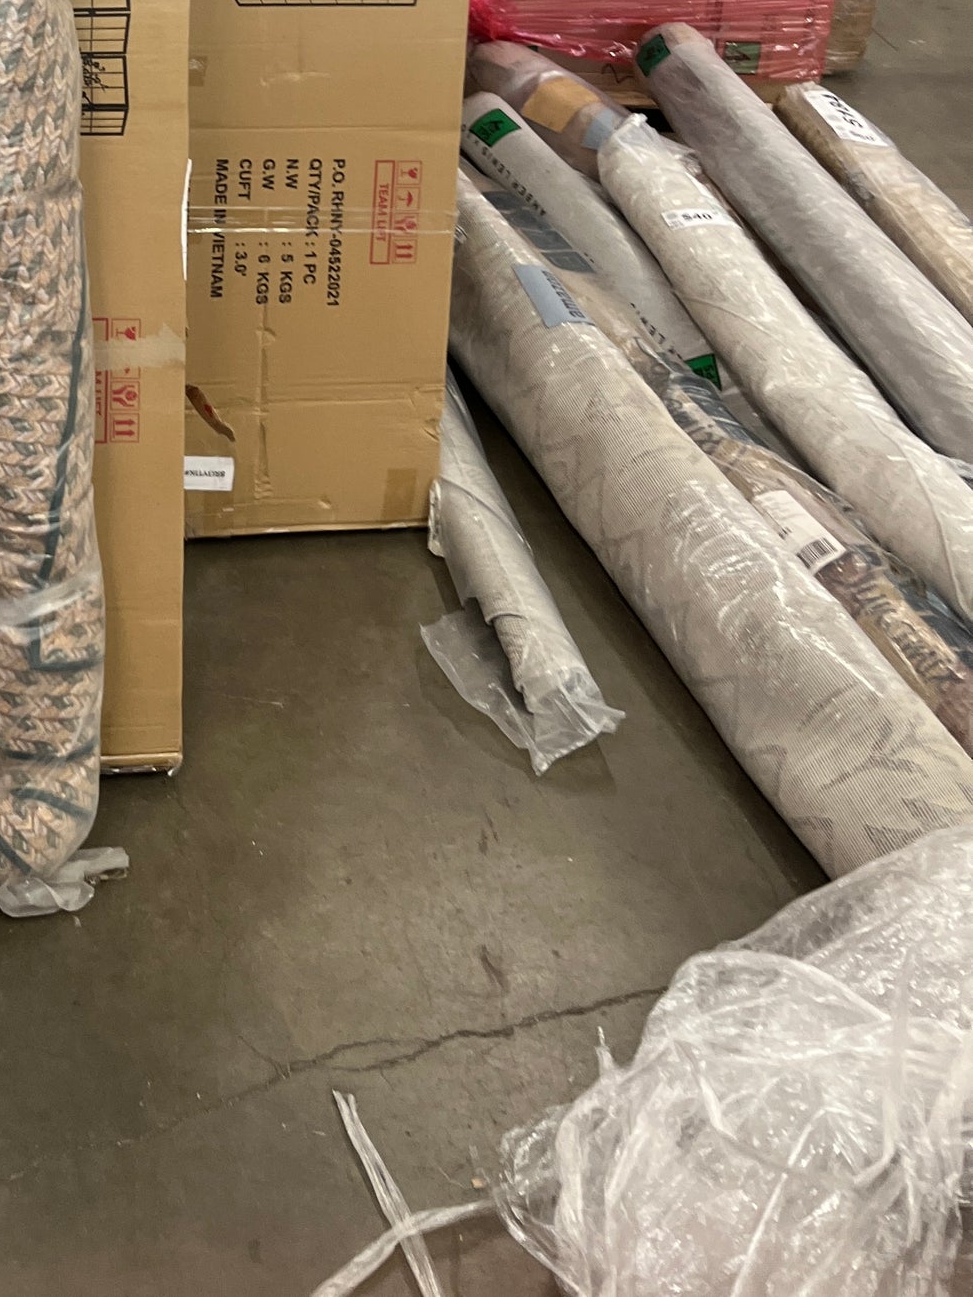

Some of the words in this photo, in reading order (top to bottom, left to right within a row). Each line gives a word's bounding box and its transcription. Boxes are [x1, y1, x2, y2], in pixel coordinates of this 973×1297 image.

[214, 159, 228, 204] MADE
[238, 159, 251, 200] CUFT
[262, 159, 275, 190] G.W
[285, 159, 298, 189] N.W
[332, 159, 345, 187] P.O.
[305, 159, 322, 236] QTY/PACK
[377, 184, 389, 215] TEAM
[214, 209, 226, 225] IN
[376, 220, 387, 242] LIFT
[210, 228, 225, 298] VIETNAM
[258, 255, 269, 263] 6
[282, 254, 293, 262] 5
[327, 191, 344, 306] RHNY-04522021
[256, 272, 269, 305] KGS
[279, 271, 292, 304] KGS
[303, 264, 316, 284] PC
